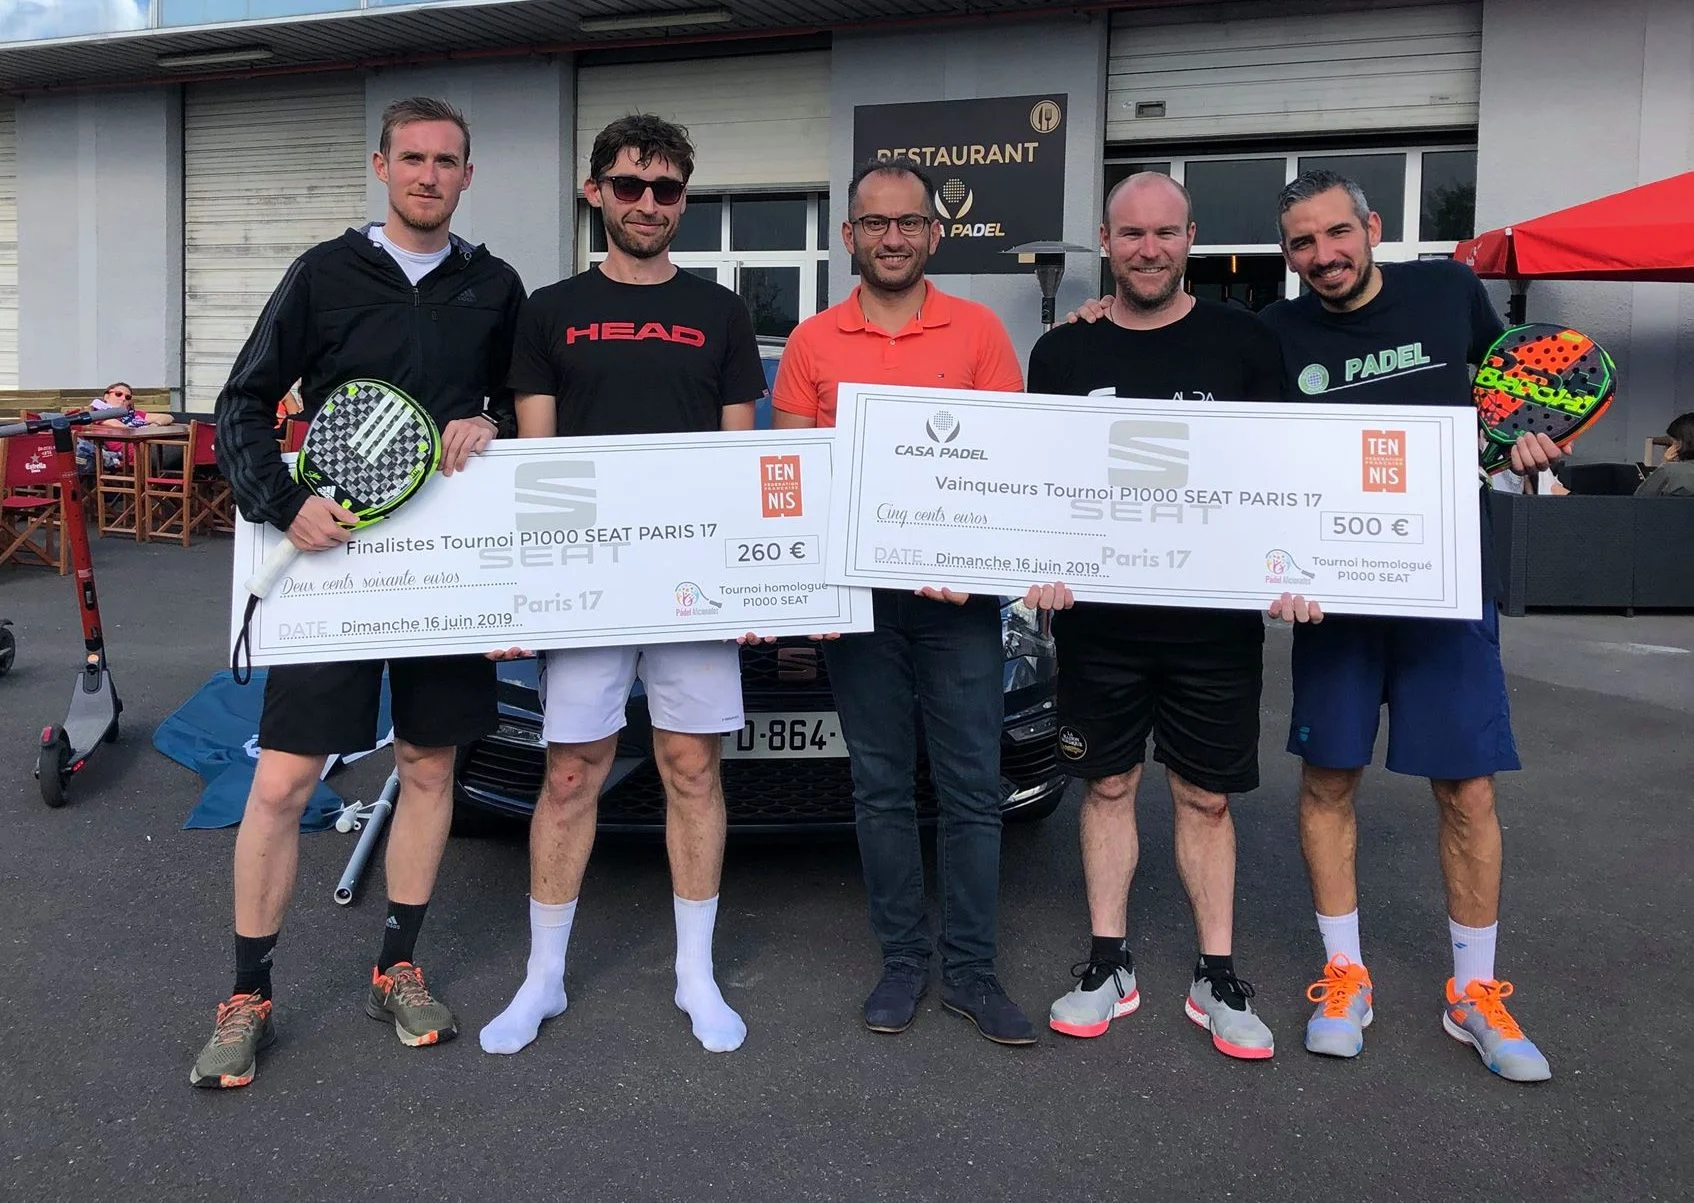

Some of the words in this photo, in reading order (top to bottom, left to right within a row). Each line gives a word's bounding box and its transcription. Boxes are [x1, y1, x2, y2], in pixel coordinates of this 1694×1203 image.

[950, 222, 1005, 237] PADEL
[566, 321, 706, 348] HEAD
[1345, 342, 1430, 382] PADEL
[894, 444, 934, 458] CASA
[939, 447, 989, 461] PADEL
[1367, 438, 1399, 456] TEN
[765, 463, 794, 481] TEN
[1369, 467, 1399, 485] NIS
[768, 491, 796, 510] NIS
[935, 476, 1038, 497] Vainqueurs
[1044, 482, 1113, 500] Tournoi
[1120, 487, 1178, 503] P1000
[1184, 489, 1233, 505] SEAT
[1239, 491, 1298, 508] PARIS
[1304, 493, 1322, 508] 17
[876, 502, 908, 528] Cinq
[914, 505, 946, 523] cents
[953, 511, 988, 525] euros
[1070, 498, 1222, 525] SEAT
[1333, 516, 1382, 536] 500
[1391, 518, 1409, 537] €
[346, 536, 435, 555] Finalistes
[441, 532, 514, 550] Tournoi
[520, 529, 578, 546] P1000
[584, 527, 632, 544] SEAT
[639, 524, 694, 541] PARIS
[700, 523, 717, 538] 17
[479, 541, 631, 570] SEAT
[738, 542, 781, 562] 260
[789, 541, 806, 560] €
[874, 546, 923, 564] DATE
[936, 552, 1012, 569] Dimanche
[1015, 557, 1030, 571] 16
[1033, 557, 1061, 574] juin
[1066, 561, 1100, 575] 2019
[1102, 546, 1159, 568] Paris
[1166, 550, 1192, 570] 17
[1312, 556, 1359, 568] Tournoi
[1361, 557, 1432, 574] homologué
[281, 575, 315, 595] Deux
[322, 573, 354, 591] cents
[363, 569, 417, 589] soixante
[423, 571, 460, 586] euros
[1338, 571, 1375, 583] P1000
[1379, 572, 1410, 584] SEAT
[720, 583, 761, 595] Tournoi
[513, 593, 572, 614] Paris
[579, 590, 604, 611] 17
[743, 596, 777, 607] P1000
[781, 594, 808, 605] SEAT
[279, 620, 328, 639] DATE
[341, 616, 420, 634] Dimanche
[424, 616, 440, 630] 16
[442, 614, 473, 632] juin
[478, 612, 513, 626] 2019
